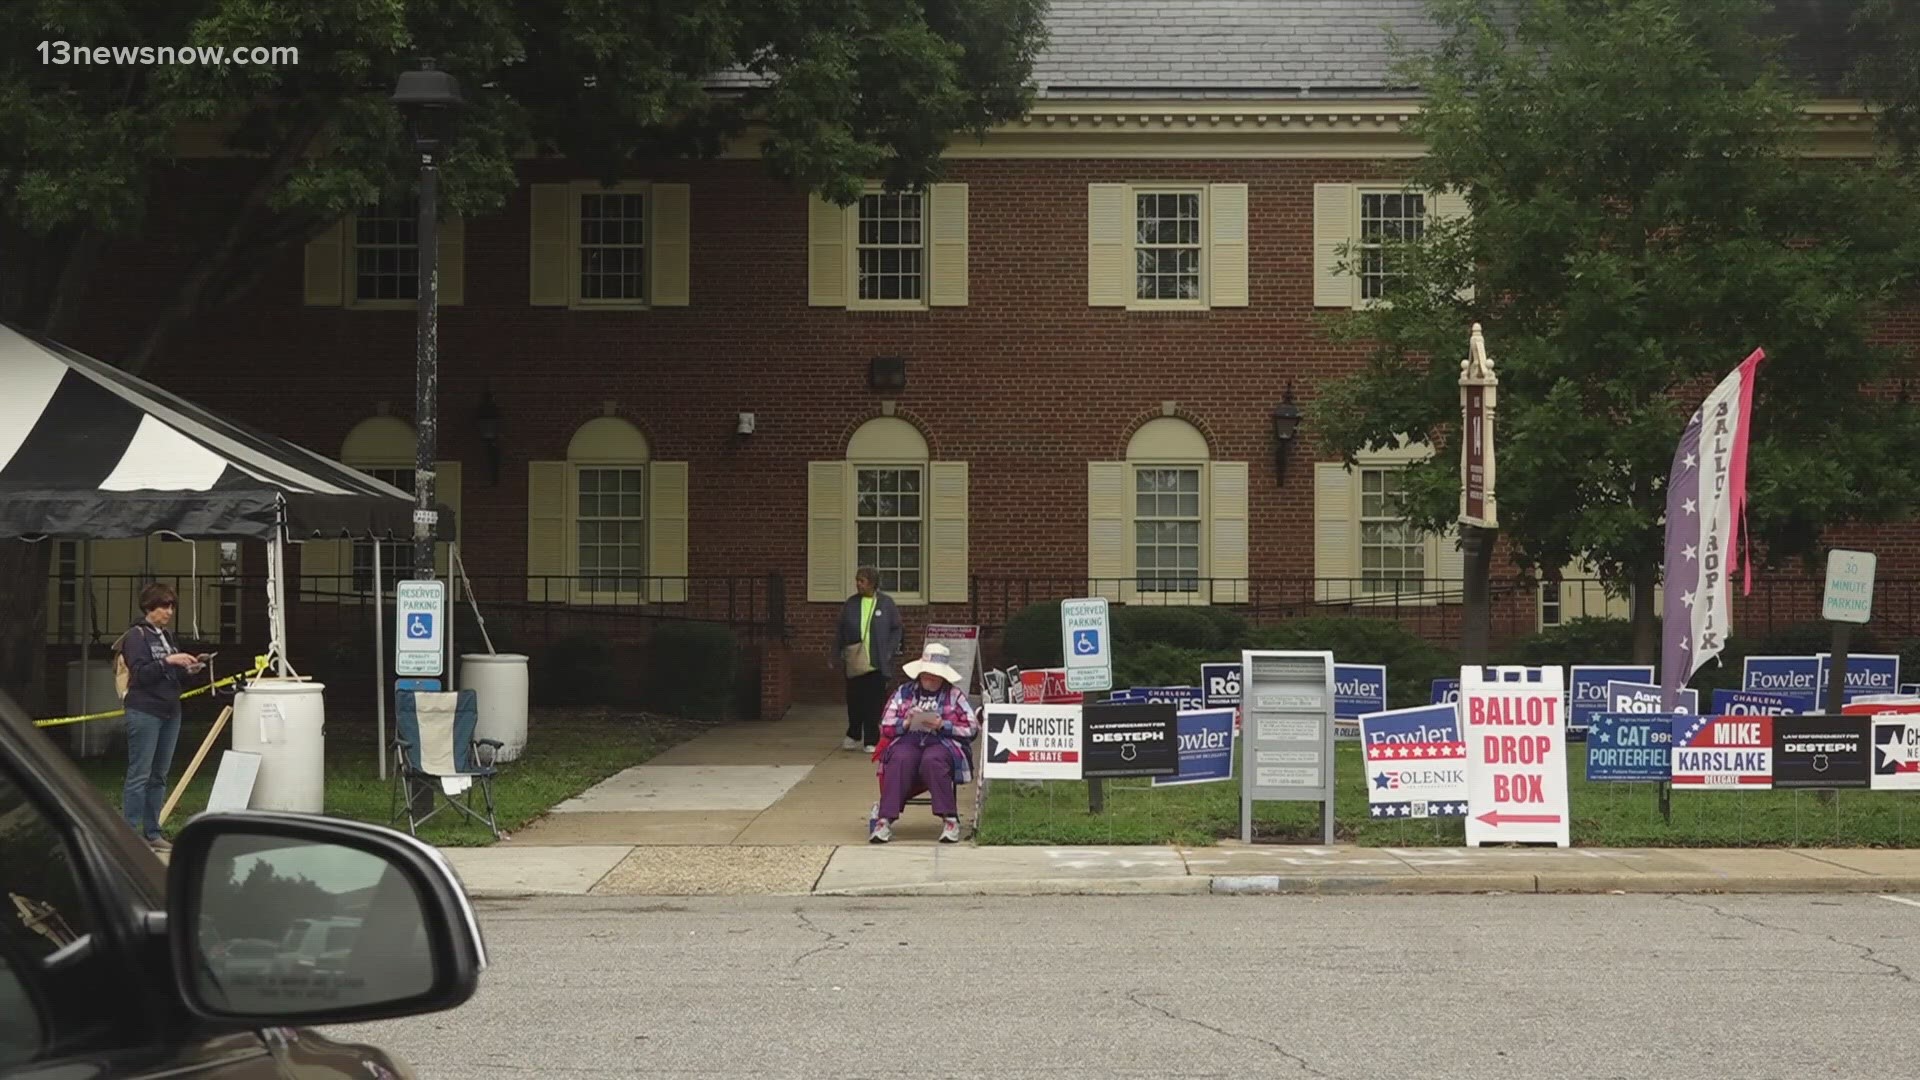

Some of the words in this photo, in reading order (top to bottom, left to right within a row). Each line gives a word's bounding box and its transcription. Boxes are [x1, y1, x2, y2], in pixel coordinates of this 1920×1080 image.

[401, 588, 440, 598] RESERVED
[1831, 580, 1867, 593] MINUTE
[403, 601, 437, 610] PARKING
[1065, 605, 1104, 616] RESERVED
[1826, 597, 1868, 611] PARKING
[1068, 617, 1102, 627] PARKING
[1750, 670, 1814, 687] Fowler
[1822, 668, 1892, 687] Fwler
[1733, 694, 1783, 705] CHARLENA
[1469, 697, 1557, 725] BALLOT
[1019, 717, 1075, 736] CHRISTIE
[1714, 722, 1761, 745] MIKE
[1092, 731, 1164, 743] DESTEPH
[1370, 725, 1452, 744] Fowler
[1617, 725, 1650, 747] CAT
[1019, 737, 1038, 749] NEW
[1044, 737, 1074, 748] CRAIG
[1484, 735, 1551, 764] DROP
[1785, 743, 1858, 753] DESTEPH
[1029, 751, 1063, 762] SENATE
[1679, 751, 1766, 772] KARSLAKE
[1400, 770, 1465, 784] OLENIK
[1704, 775, 1739, 785] DELEGATE
[1494, 774, 1545, 803] BOX
